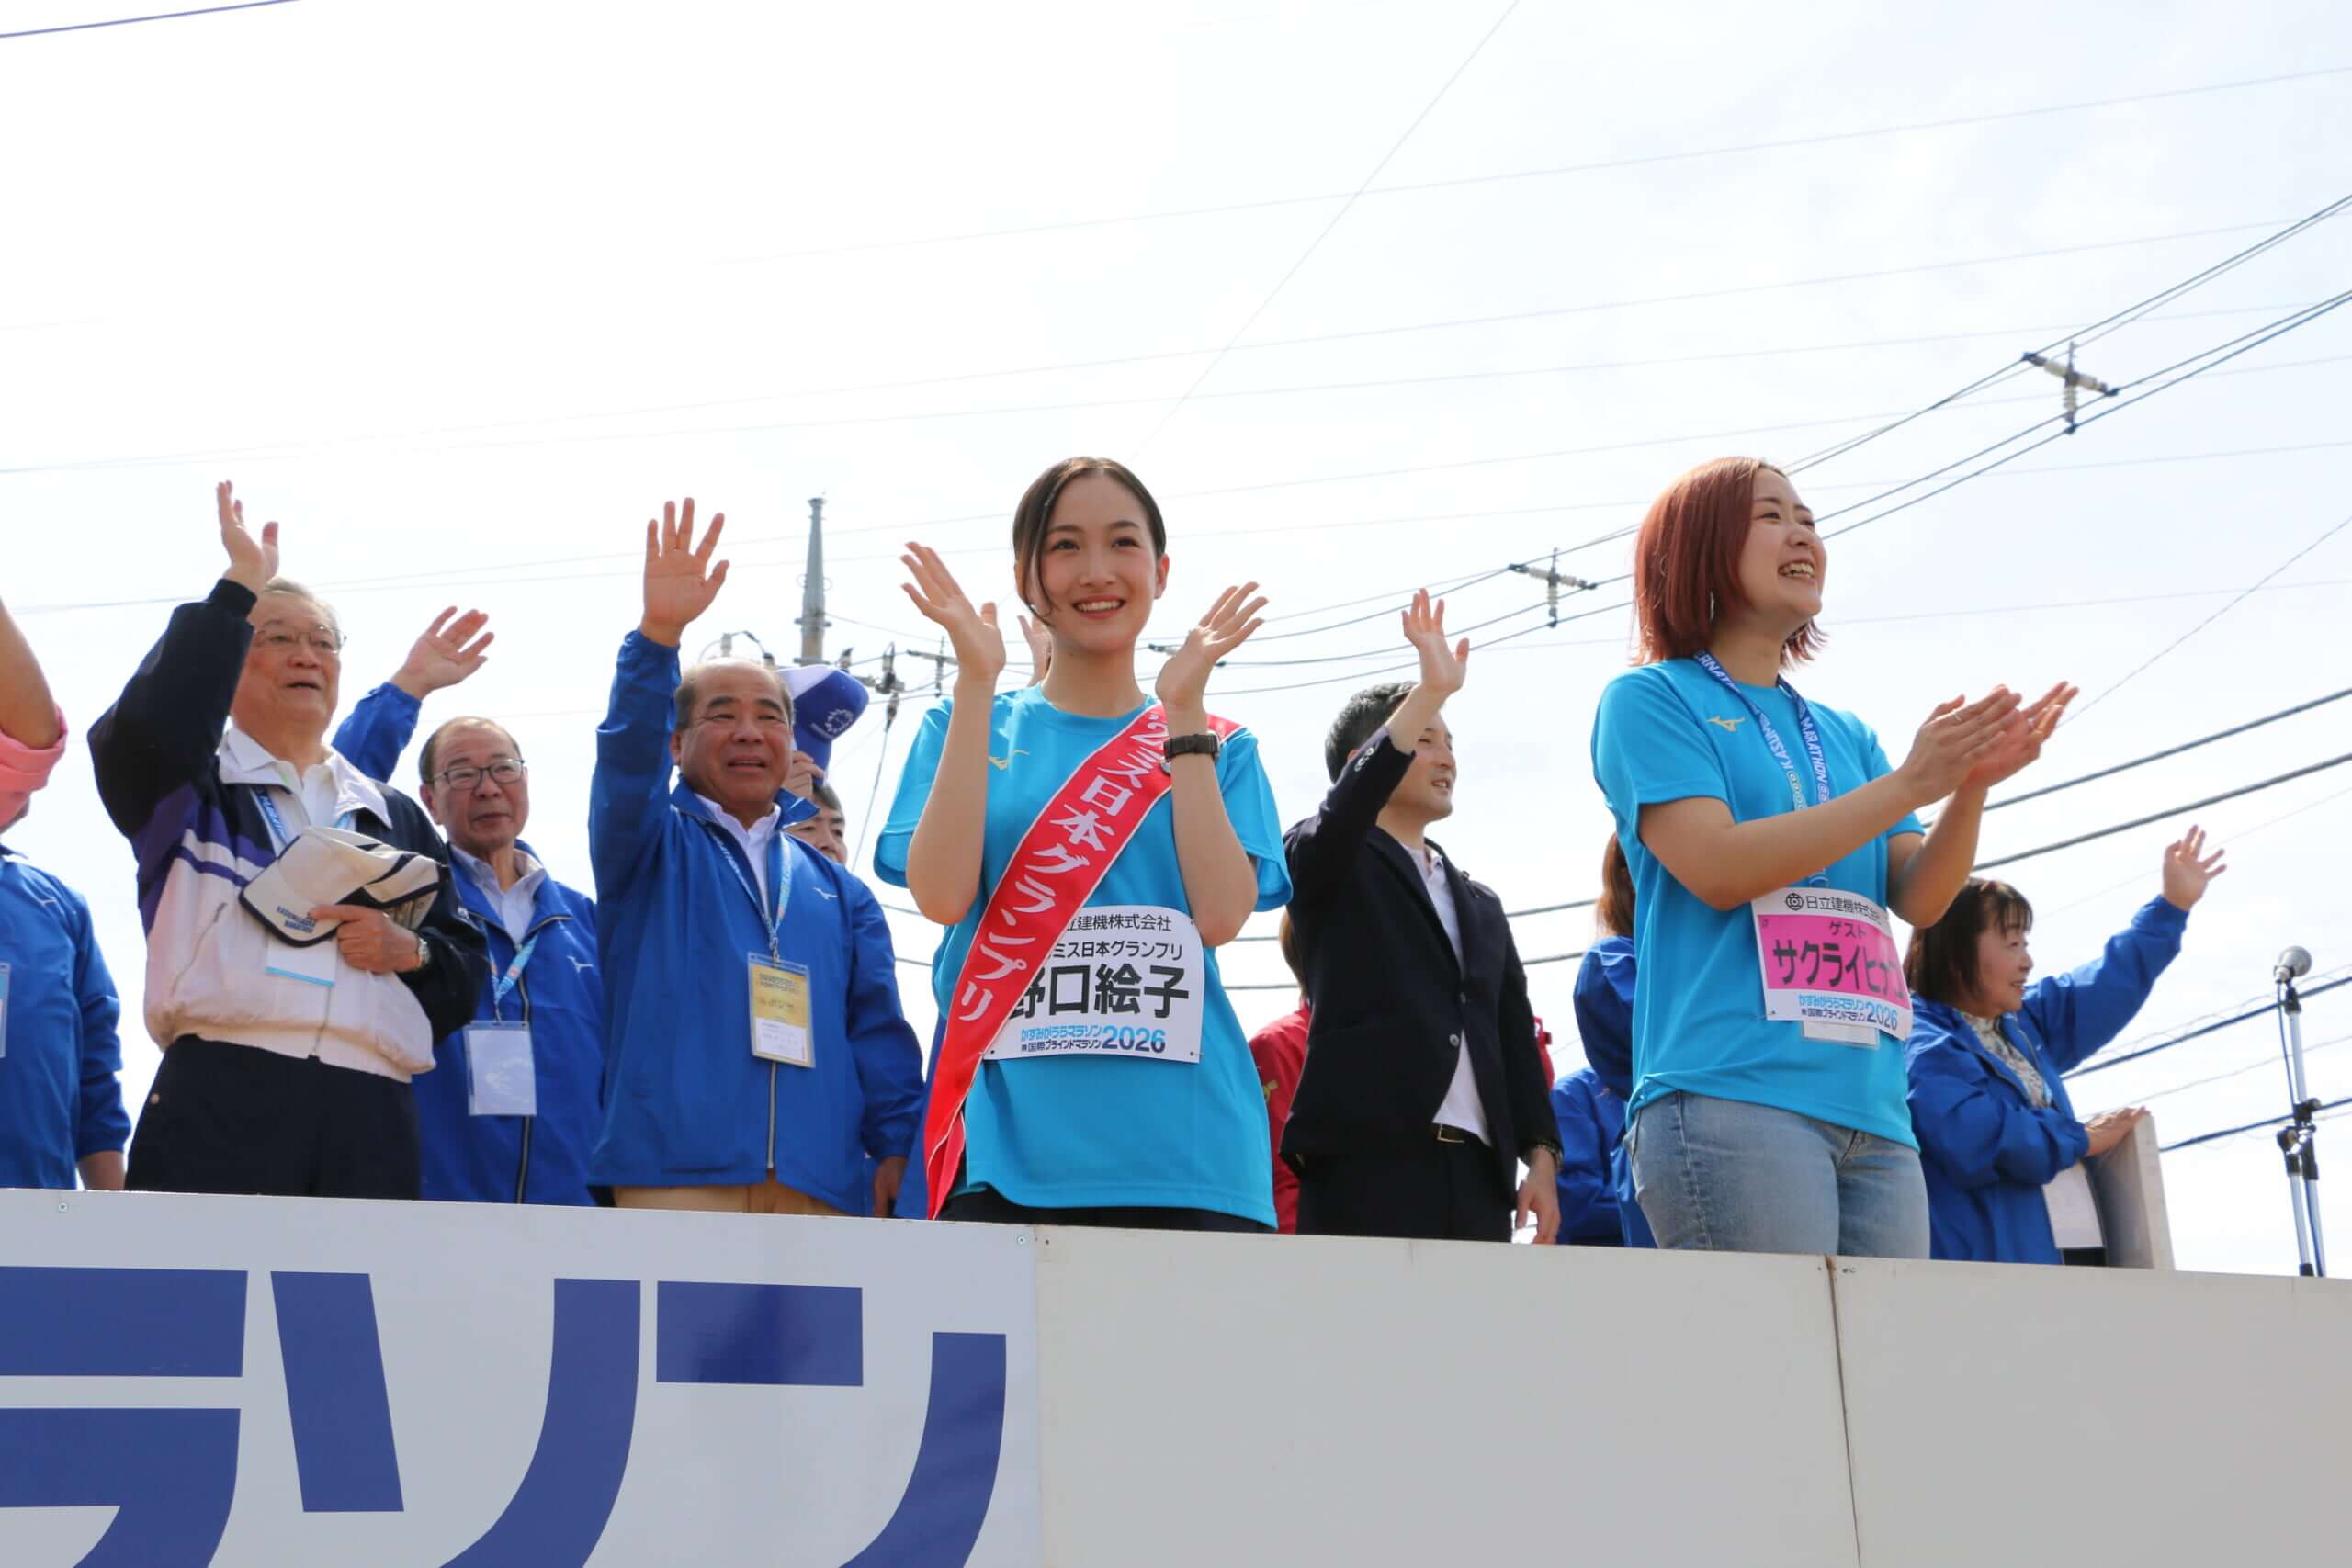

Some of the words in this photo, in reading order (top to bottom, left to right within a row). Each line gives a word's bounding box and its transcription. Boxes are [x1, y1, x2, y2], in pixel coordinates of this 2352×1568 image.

[1800, 716, 1828, 784] MARATHON
[1829, 920, 1866, 940] ゲスト
[1866, 999, 1899, 1031] 2026
[1102, 1024, 1166, 1054] 2026
